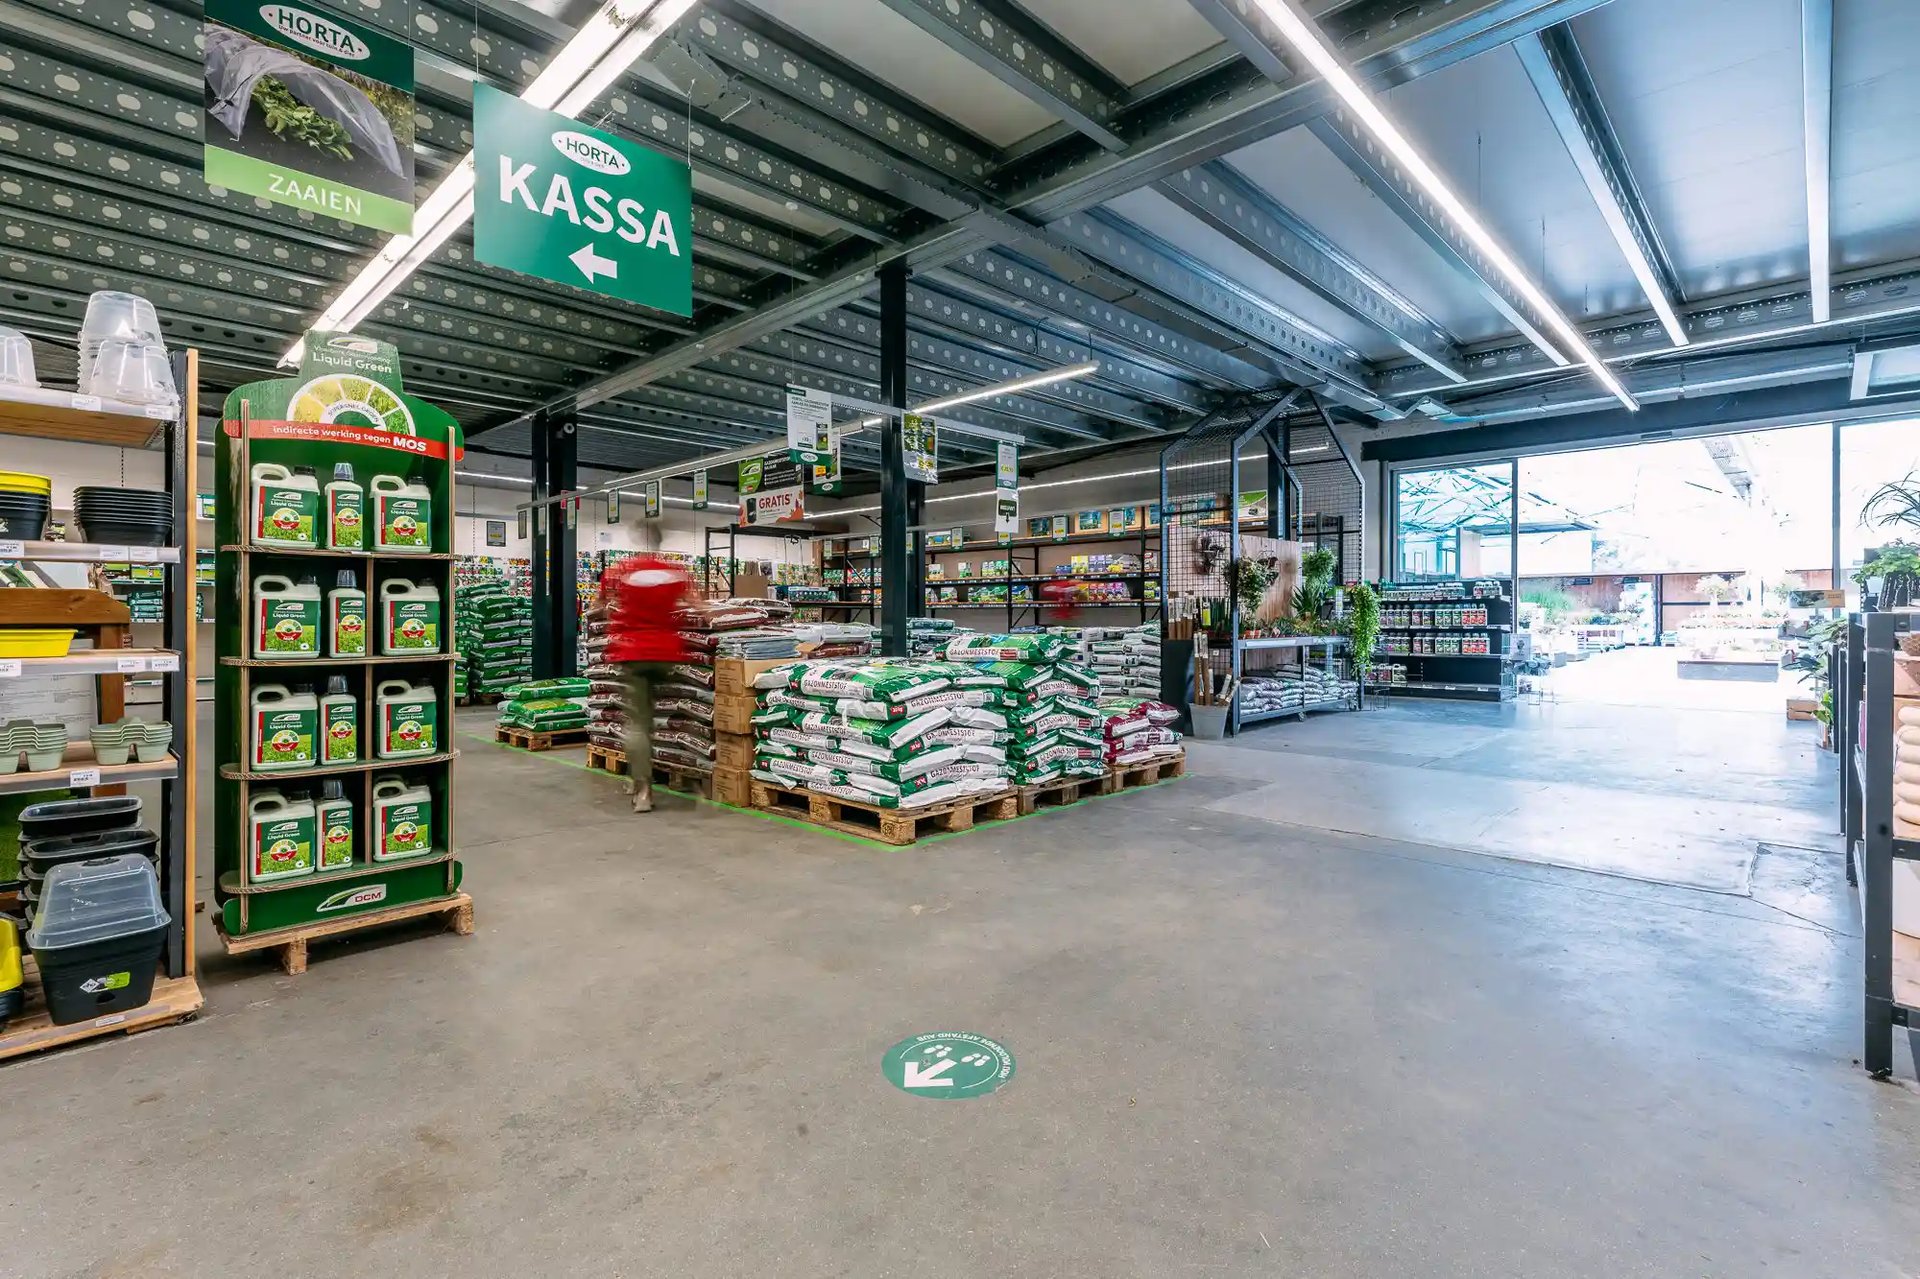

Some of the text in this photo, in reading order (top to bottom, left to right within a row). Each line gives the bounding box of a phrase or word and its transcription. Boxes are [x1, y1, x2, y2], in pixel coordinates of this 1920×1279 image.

[278, 8, 355, 53] HORTA
[566, 137, 620, 169] HORTA
[268, 172, 361, 216] ZAAIEN
[500, 154, 681, 257] KASSA
[313, 352, 393, 374] Liquid Green
[273, 425, 427, 452] indirecte werking tegen MOS
[759, 493, 791, 509] GRATIS
[804, 680, 848, 690] GAZONMESTSTOF
[910, 692, 965, 707] GAZONMESTSTOF
[773, 729, 812, 741] GAZONMESTSTOF
[804, 722, 847, 735] GAZONMESTSTOF
[811, 751, 853, 765] GAZONMESTSTOF
[773, 760, 814, 774] GAZONMESTSTOF
[354, 891, 382, 903] DCM
[916, 1034, 935, 1042] AUB
[937, 1032, 980, 1041] AFSTAND
